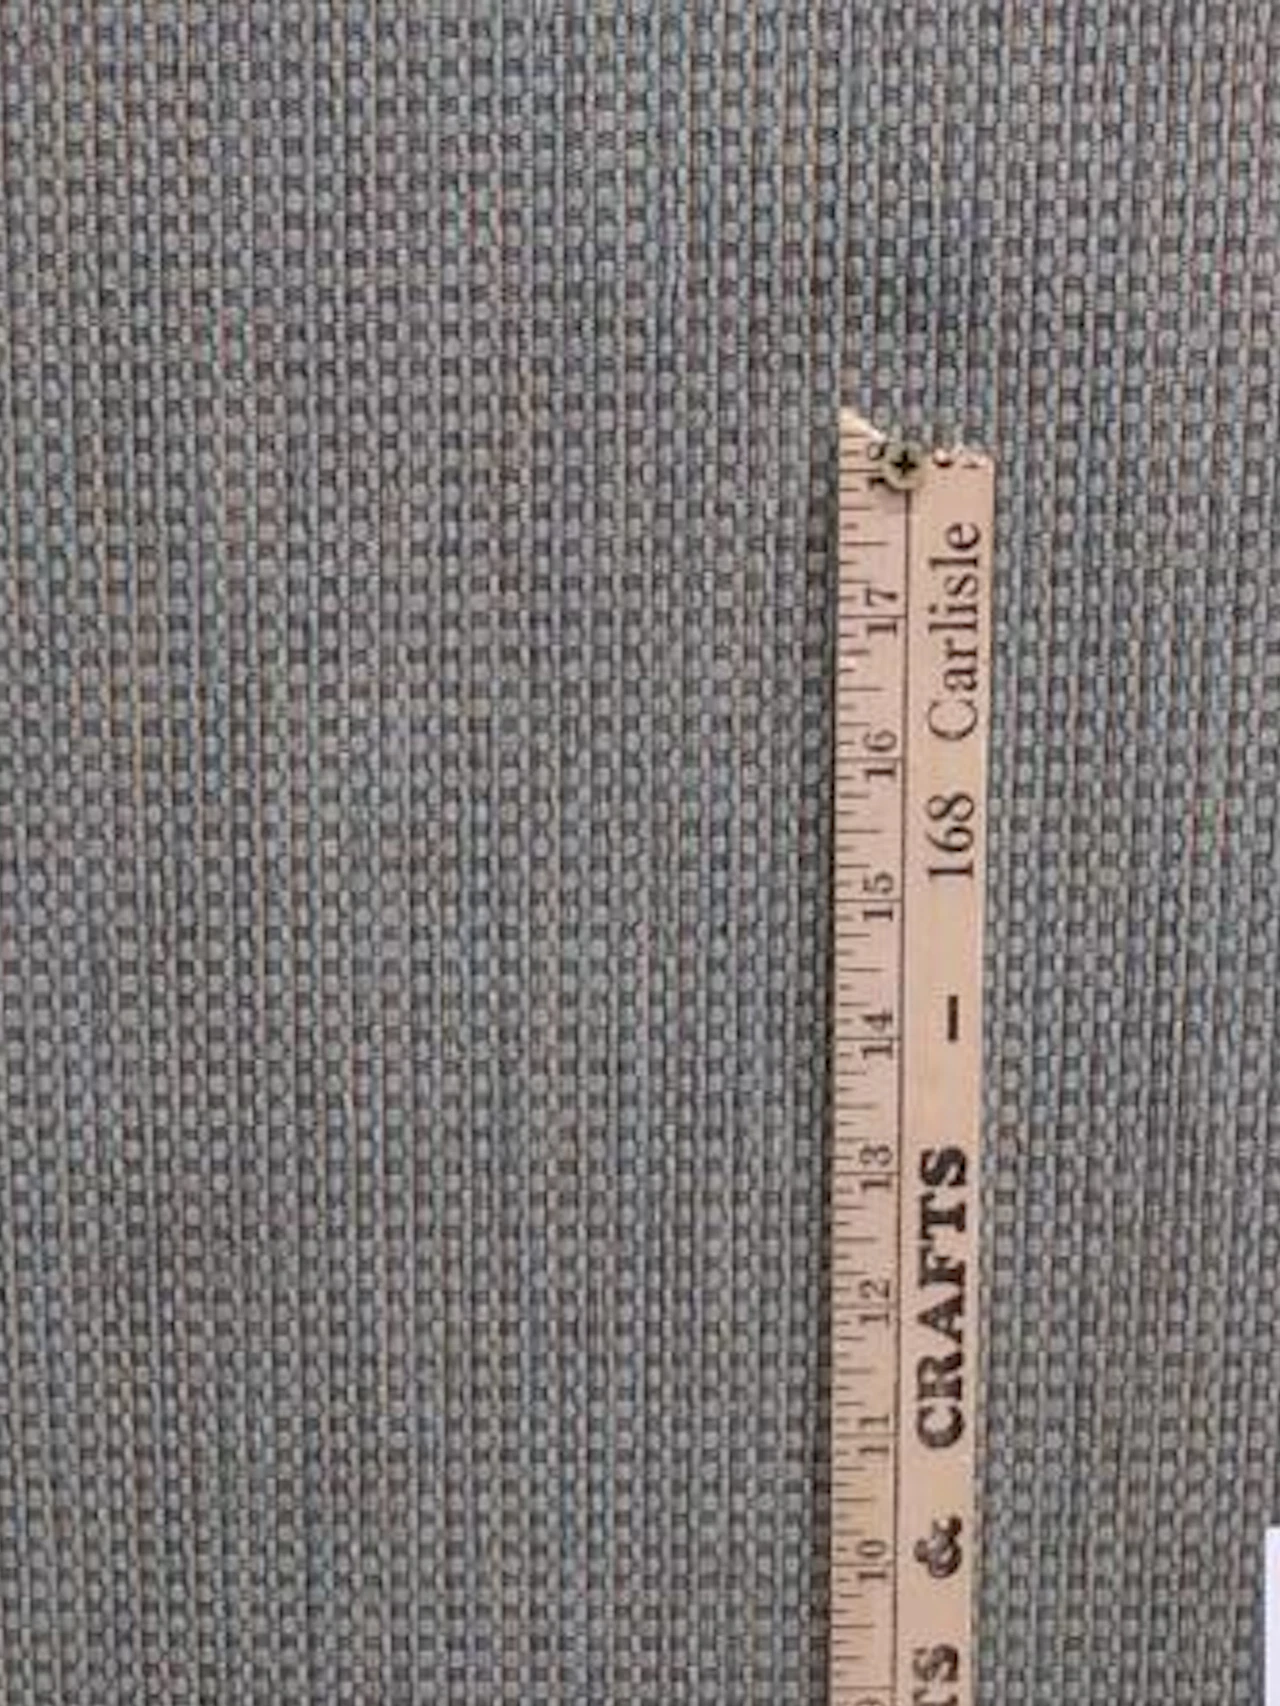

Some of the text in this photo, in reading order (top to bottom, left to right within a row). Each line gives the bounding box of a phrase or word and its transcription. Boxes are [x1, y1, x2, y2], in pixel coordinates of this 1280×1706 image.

[866, 587, 900, 635] 17
[927, 520, 982, 743] Carlisle
[864, 728, 898, 780] 16
[926, 792, 976, 880] 168
[862, 871, 895, 923] 15
[862, 1009, 894, 1060] 14
[859, 1143, 892, 1194] 13
[858, 1278, 891, 1326] 12
[916, 1144, 968, 1450] CRAFTS
[858, 1413, 889, 1457] 11
[856, 1539, 888, 1582] 10
[914, 1513, 963, 1579] &
